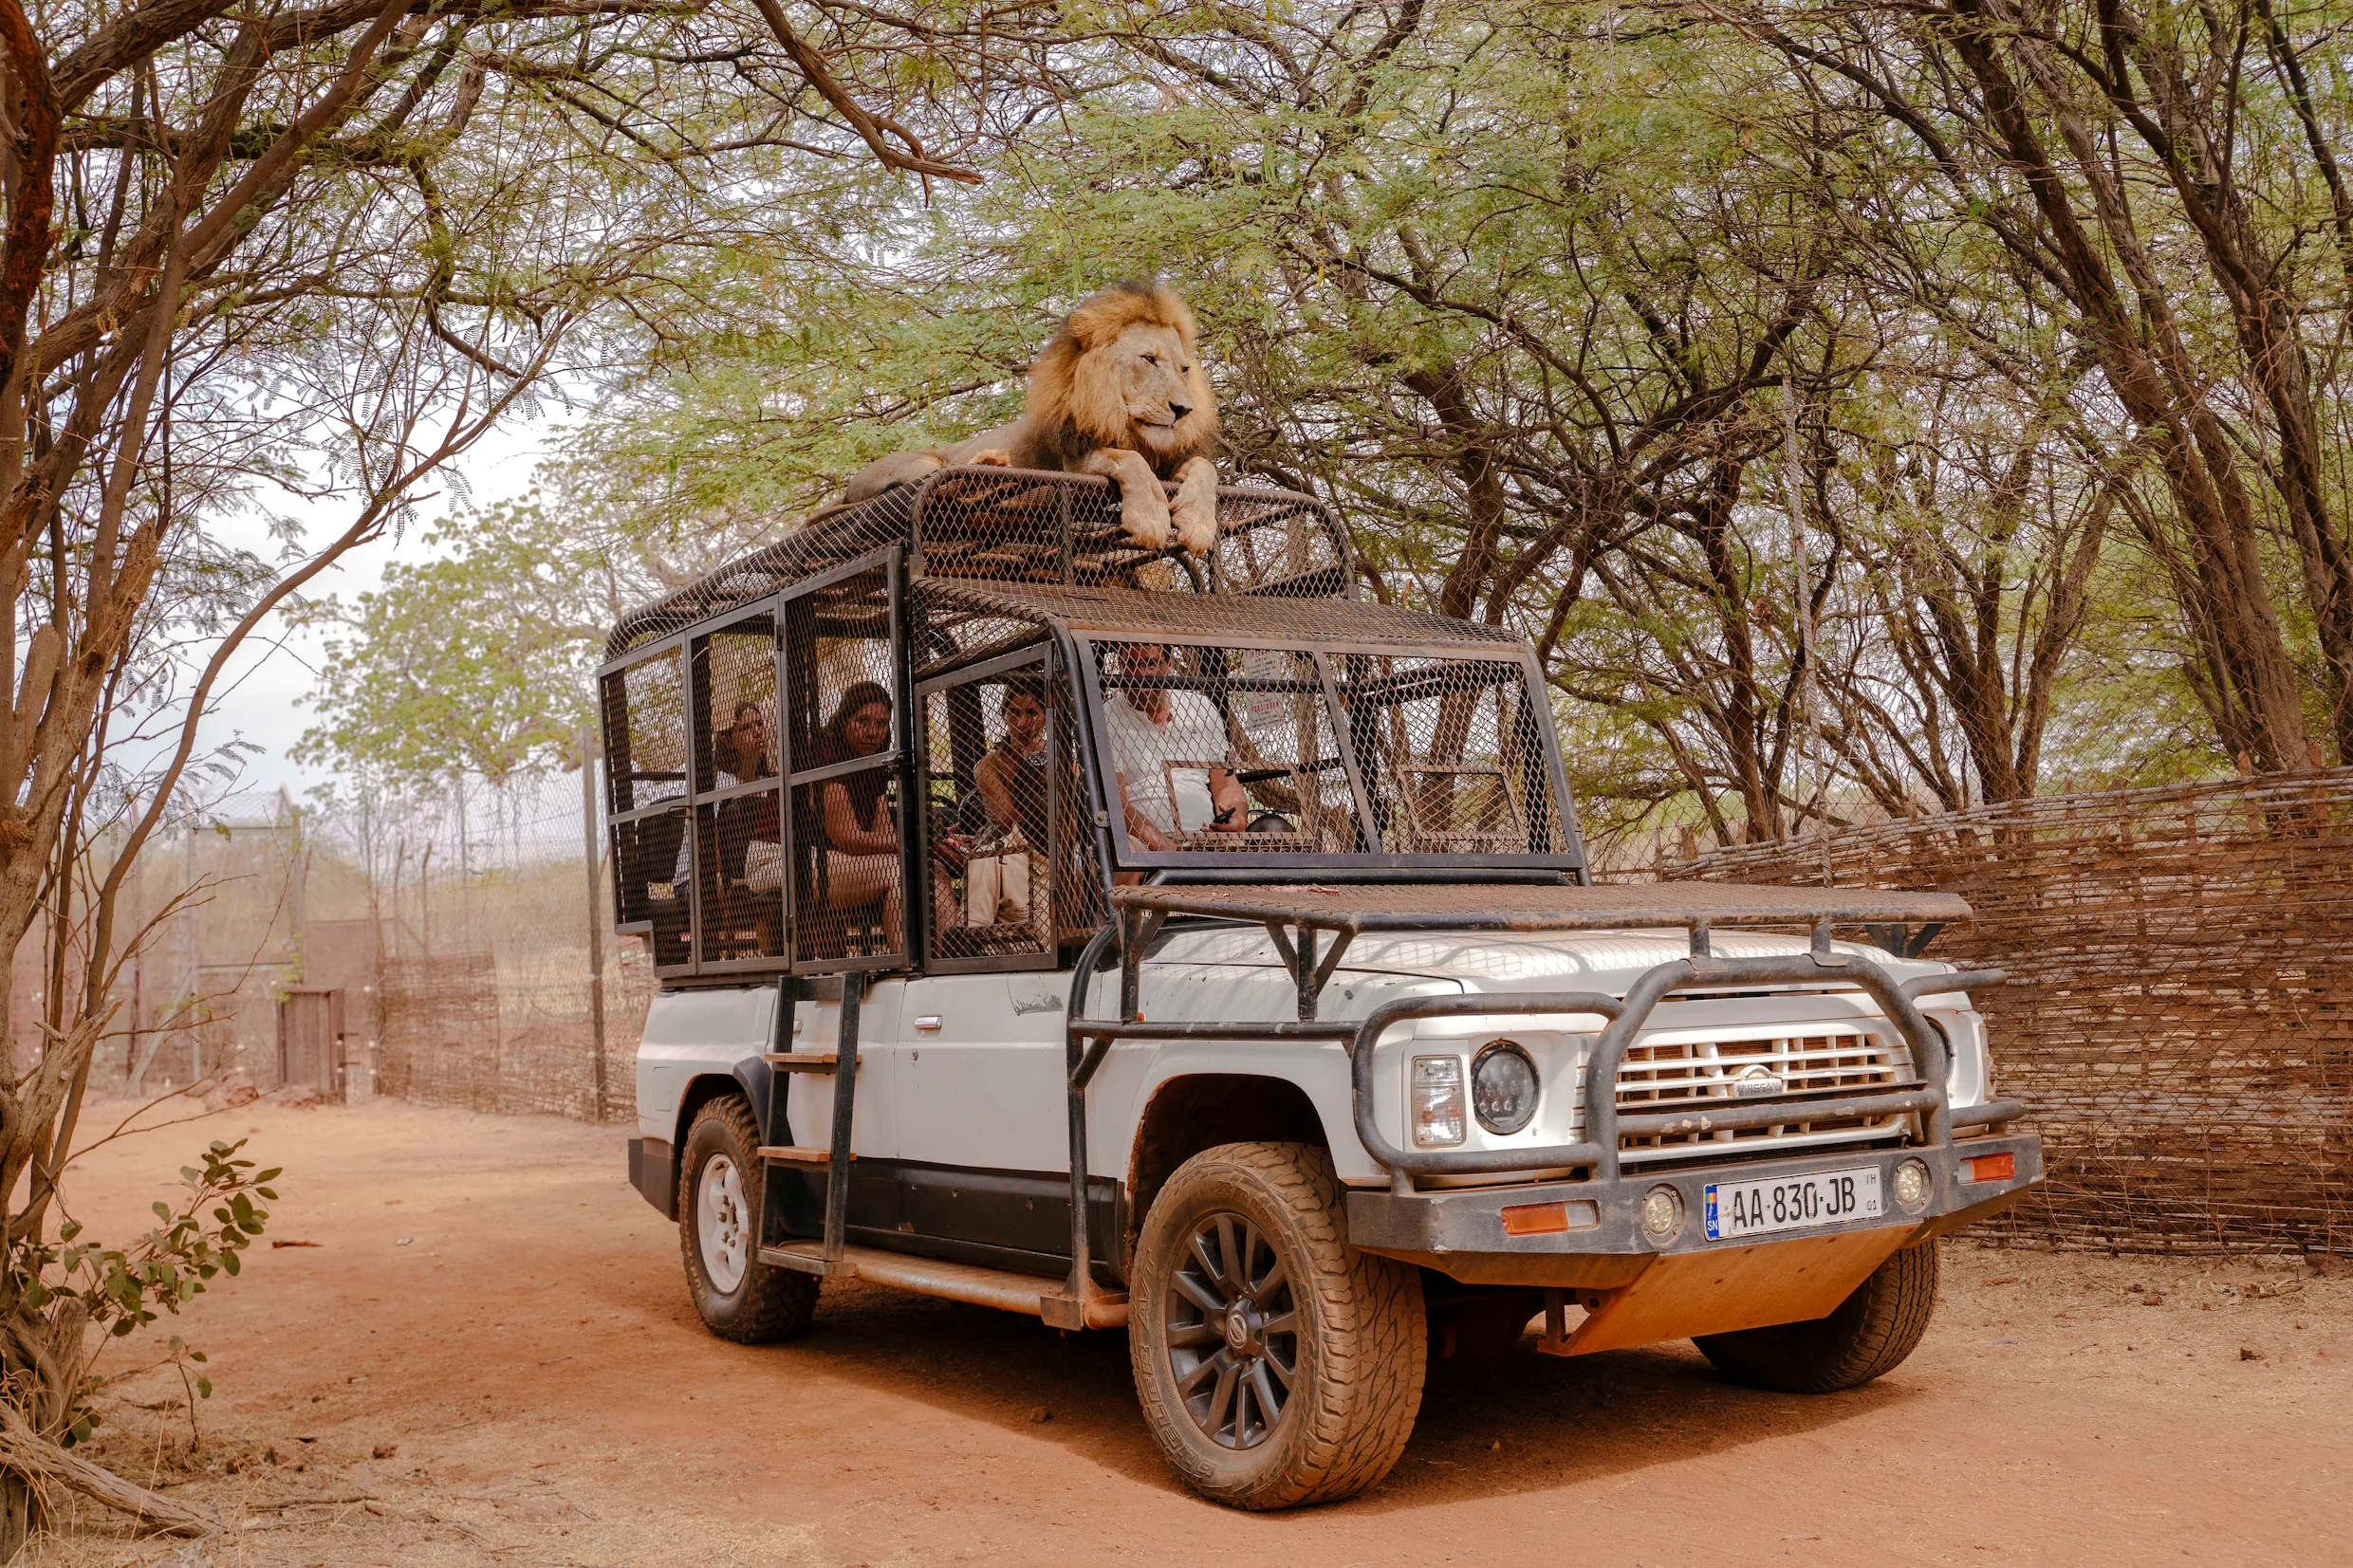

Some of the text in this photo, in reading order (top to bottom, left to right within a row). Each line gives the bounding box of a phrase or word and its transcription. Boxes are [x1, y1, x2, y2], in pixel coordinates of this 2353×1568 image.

[1737, 1082, 1780, 1096] NISSAN
[1707, 1220, 1719, 1231] SN
[1139, 1344, 1219, 1477] DUELER
